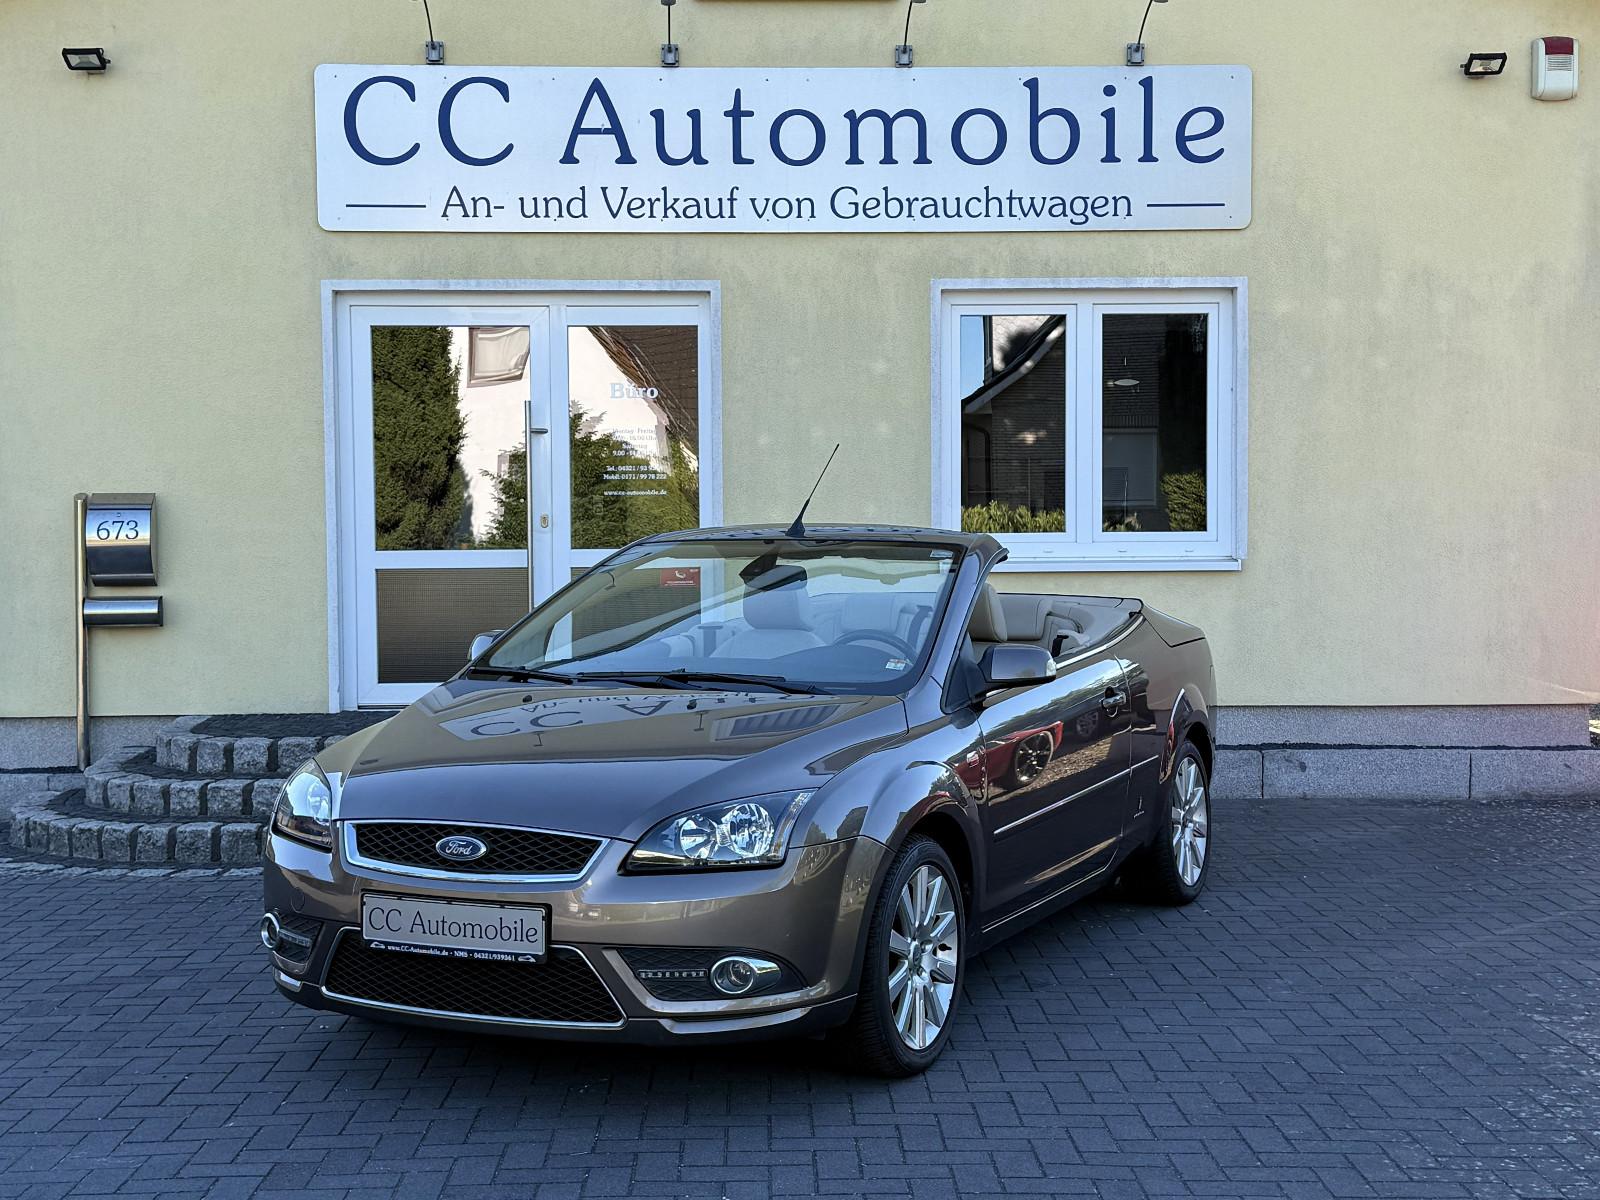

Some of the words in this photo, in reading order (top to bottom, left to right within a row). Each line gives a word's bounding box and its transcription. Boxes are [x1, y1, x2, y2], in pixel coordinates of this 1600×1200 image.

[343, 75, 514, 166] CC
[559, 75, 1225, 166] Automobile
[440, 185, 505, 219] An-
[518, 186, 589, 219] und
[600, 186, 739, 219] Verkauf
[749, 195, 816, 219] von
[830, 185, 1133, 225] Gebrauchtwagen
[610, 383, 659, 399] Büro
[96, 519, 139, 541] 673
[445, 840, 473, 855] Ford
[368, 906, 402, 933] CC
[409, 910, 538, 944] Automobile
[454, 950, 468, 958] NMS
